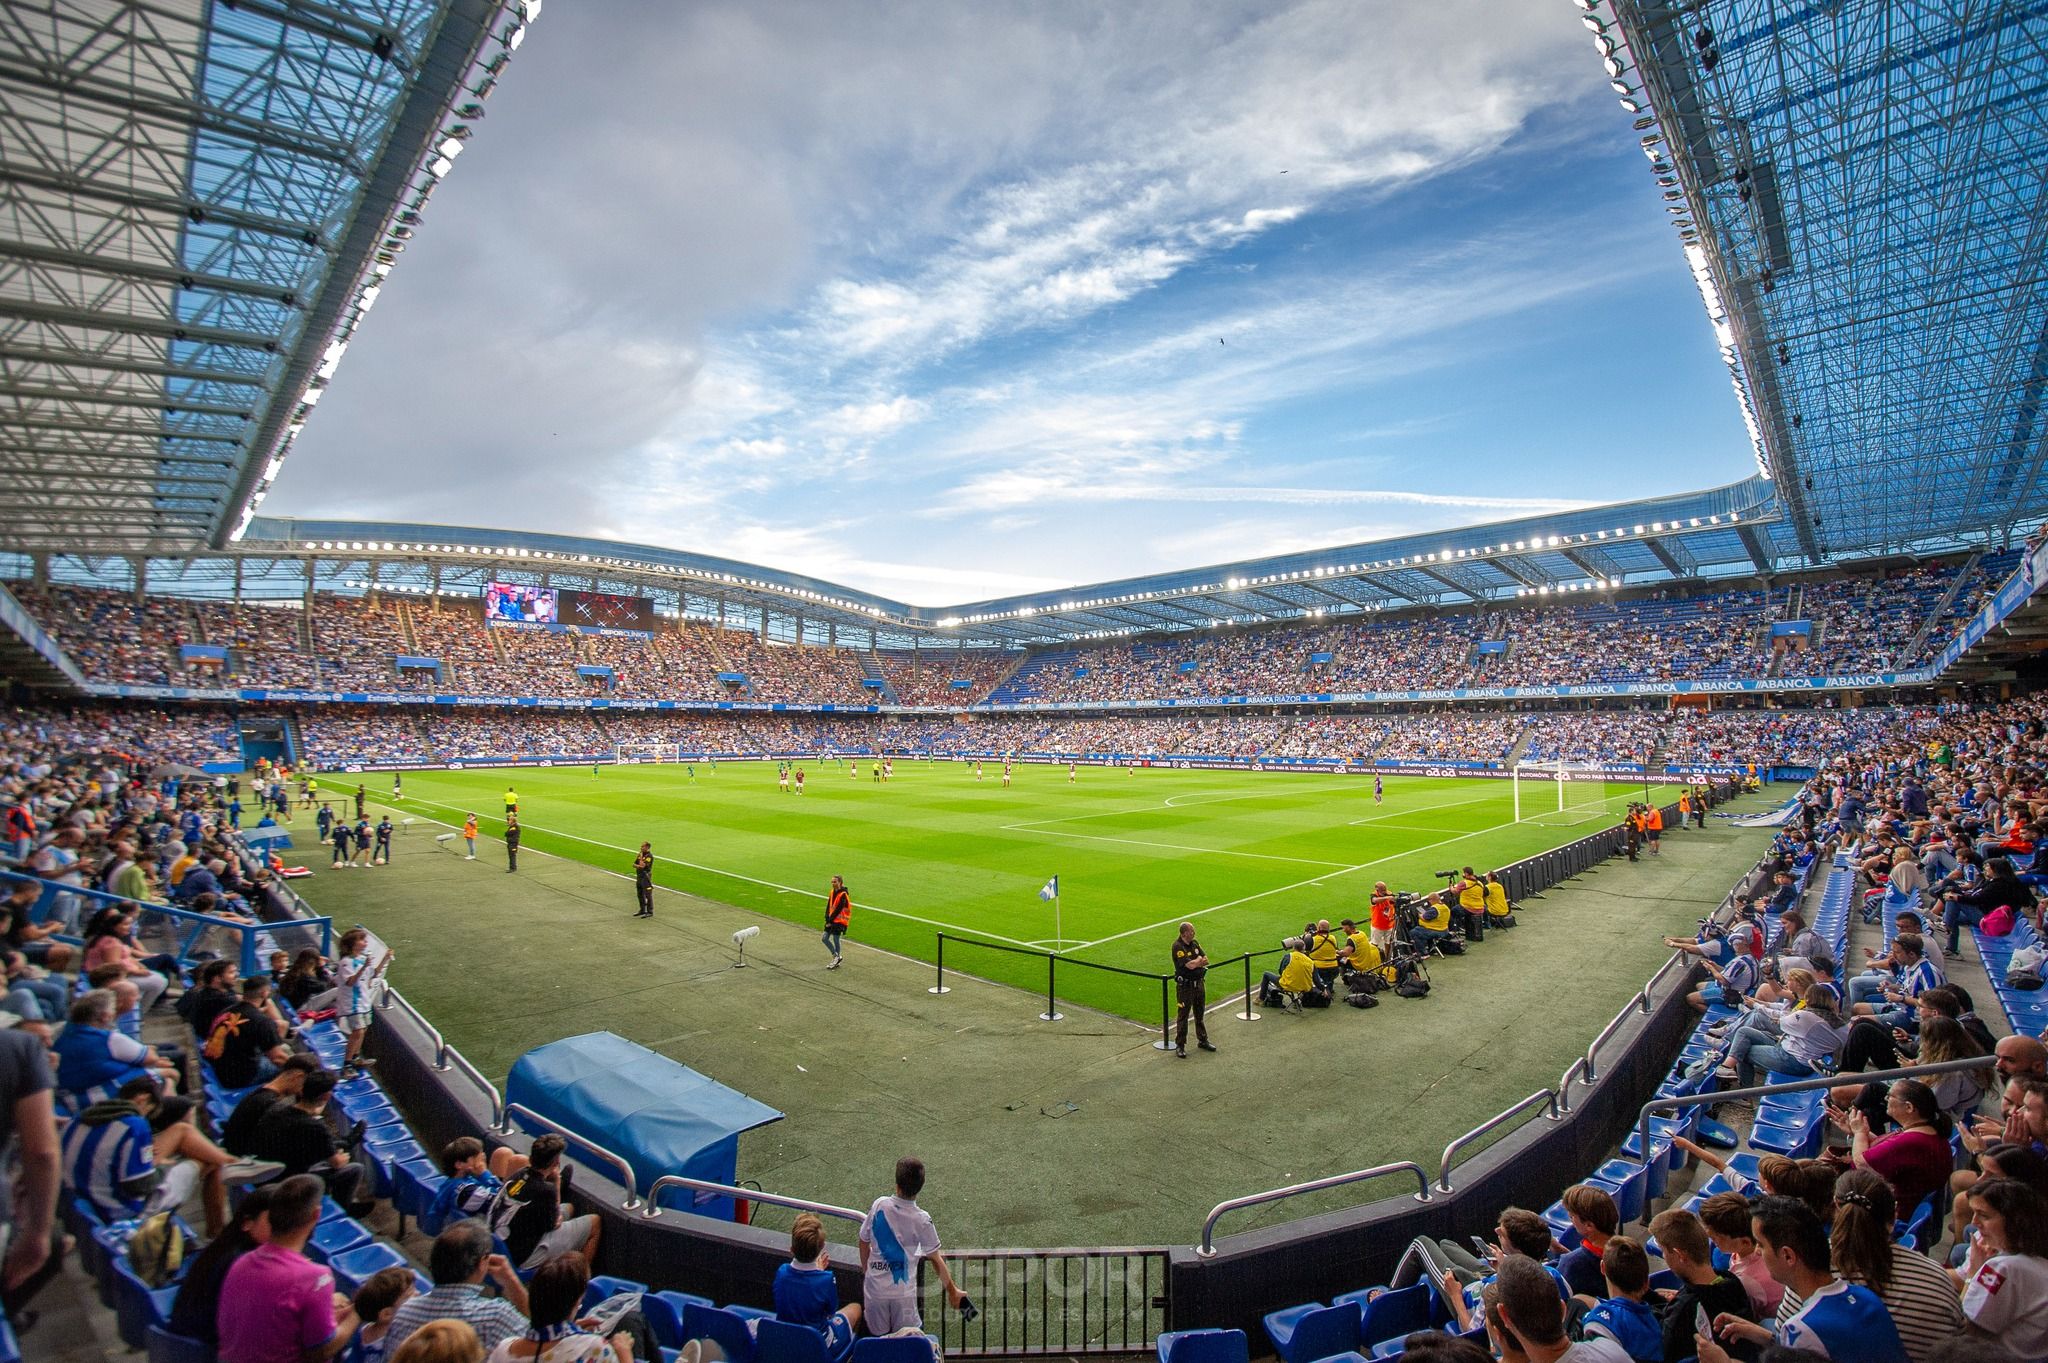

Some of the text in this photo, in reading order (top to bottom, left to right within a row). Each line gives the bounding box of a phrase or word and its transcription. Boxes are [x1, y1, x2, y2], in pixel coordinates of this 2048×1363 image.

[265, 692, 300, 700] Estrella
[367, 694, 425, 703] Estrella Galicia
[457, 696, 509, 705] Estrella Galicia
[1246, 695, 1301, 704] ABANCA RIAZOR
[1646, 774, 1682, 782] AUTOMÓVIL
